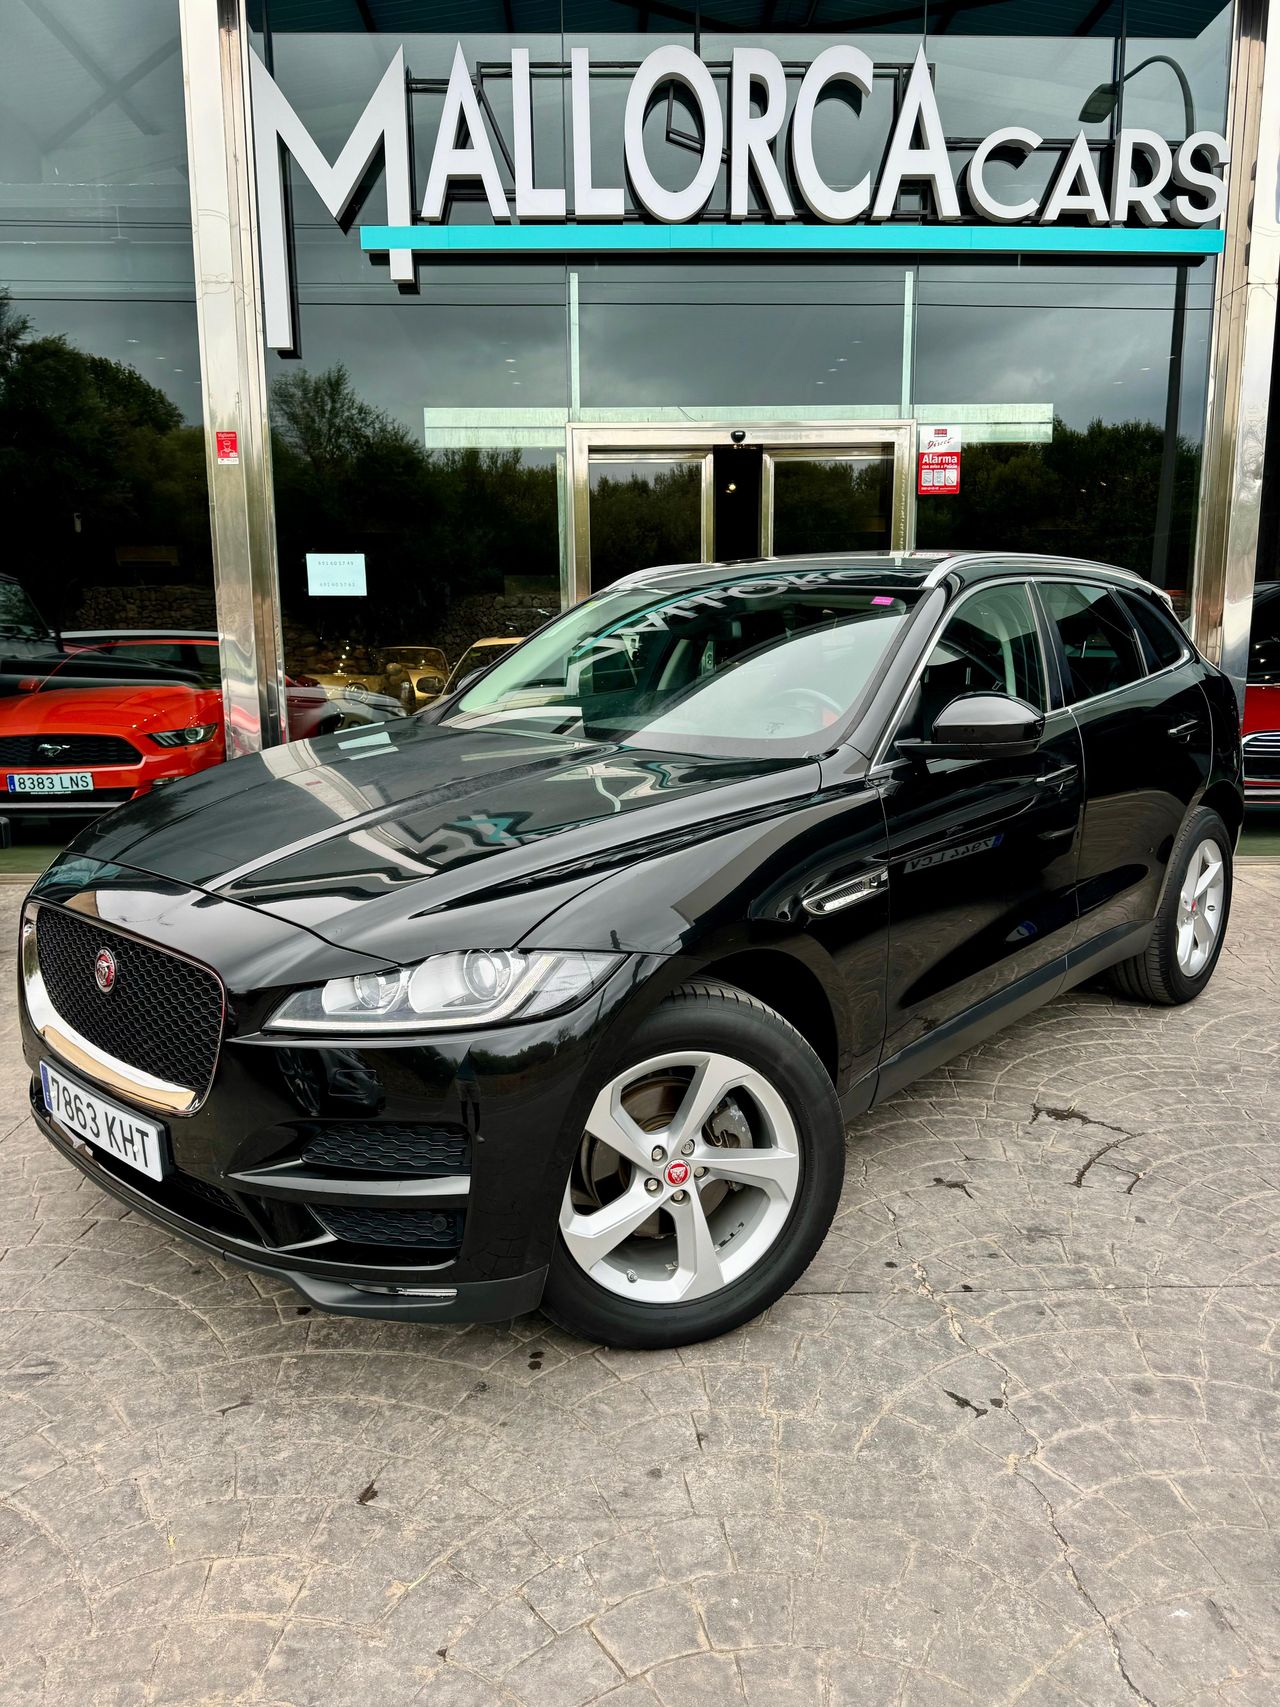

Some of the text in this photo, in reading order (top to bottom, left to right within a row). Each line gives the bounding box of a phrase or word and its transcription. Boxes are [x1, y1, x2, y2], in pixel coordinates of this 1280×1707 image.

[249, 40, 1230, 350] MALLORCA CARS
[922, 454, 958, 464] Alarma
[17, 775, 89, 790] 8383 LNS
[51, 1075, 149, 1168] 7863 KHT
